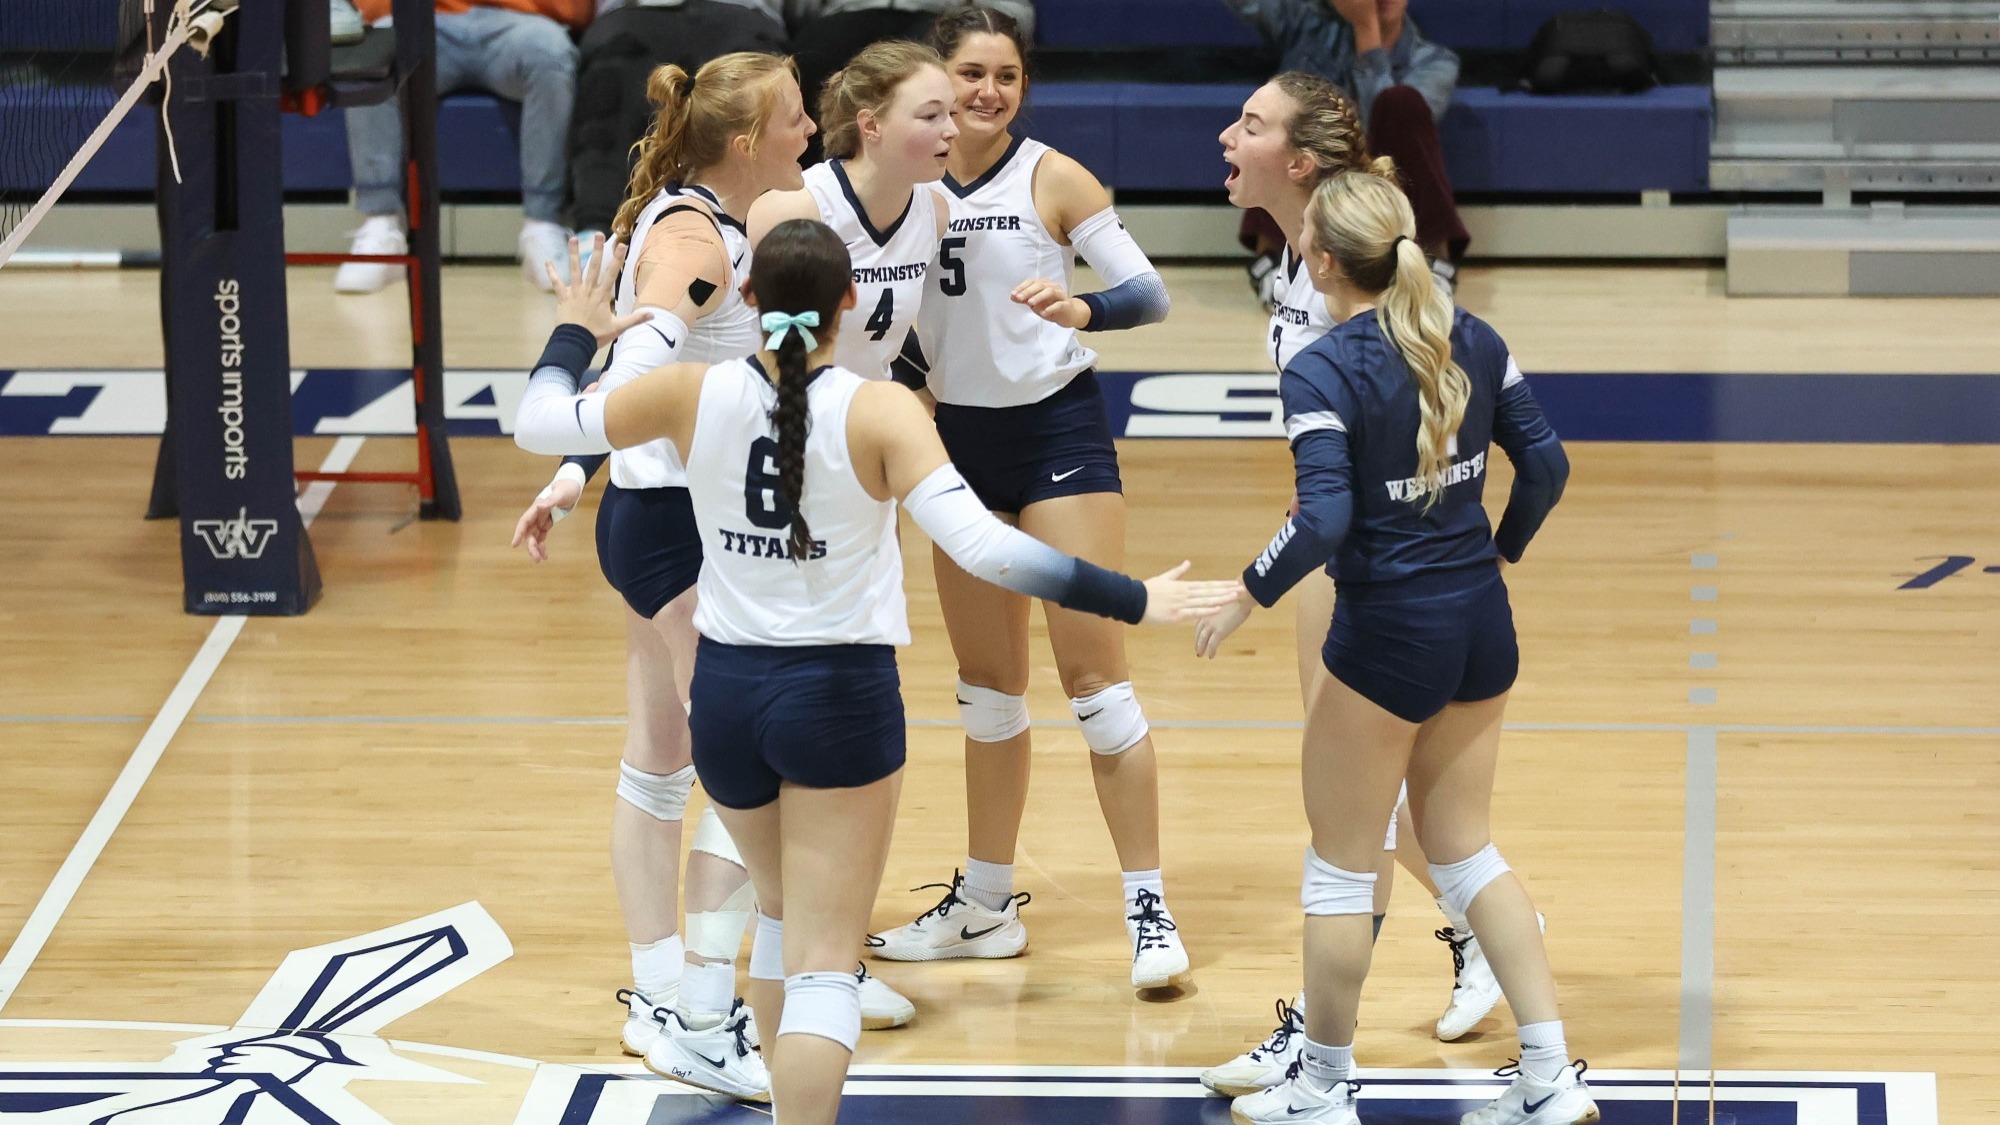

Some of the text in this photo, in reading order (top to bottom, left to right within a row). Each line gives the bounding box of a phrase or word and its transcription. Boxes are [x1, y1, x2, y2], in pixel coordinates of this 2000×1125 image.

[948, 216, 1020, 232] MINSTER
[852, 262, 927, 283] STMINSTER
[939, 237, 967, 297] 5
[864, 288, 894, 341] 4
[214, 279, 249, 480] sports imports
[744, 436, 794, 530] 6
[1385, 451, 1485, 501] WESMINSTE
